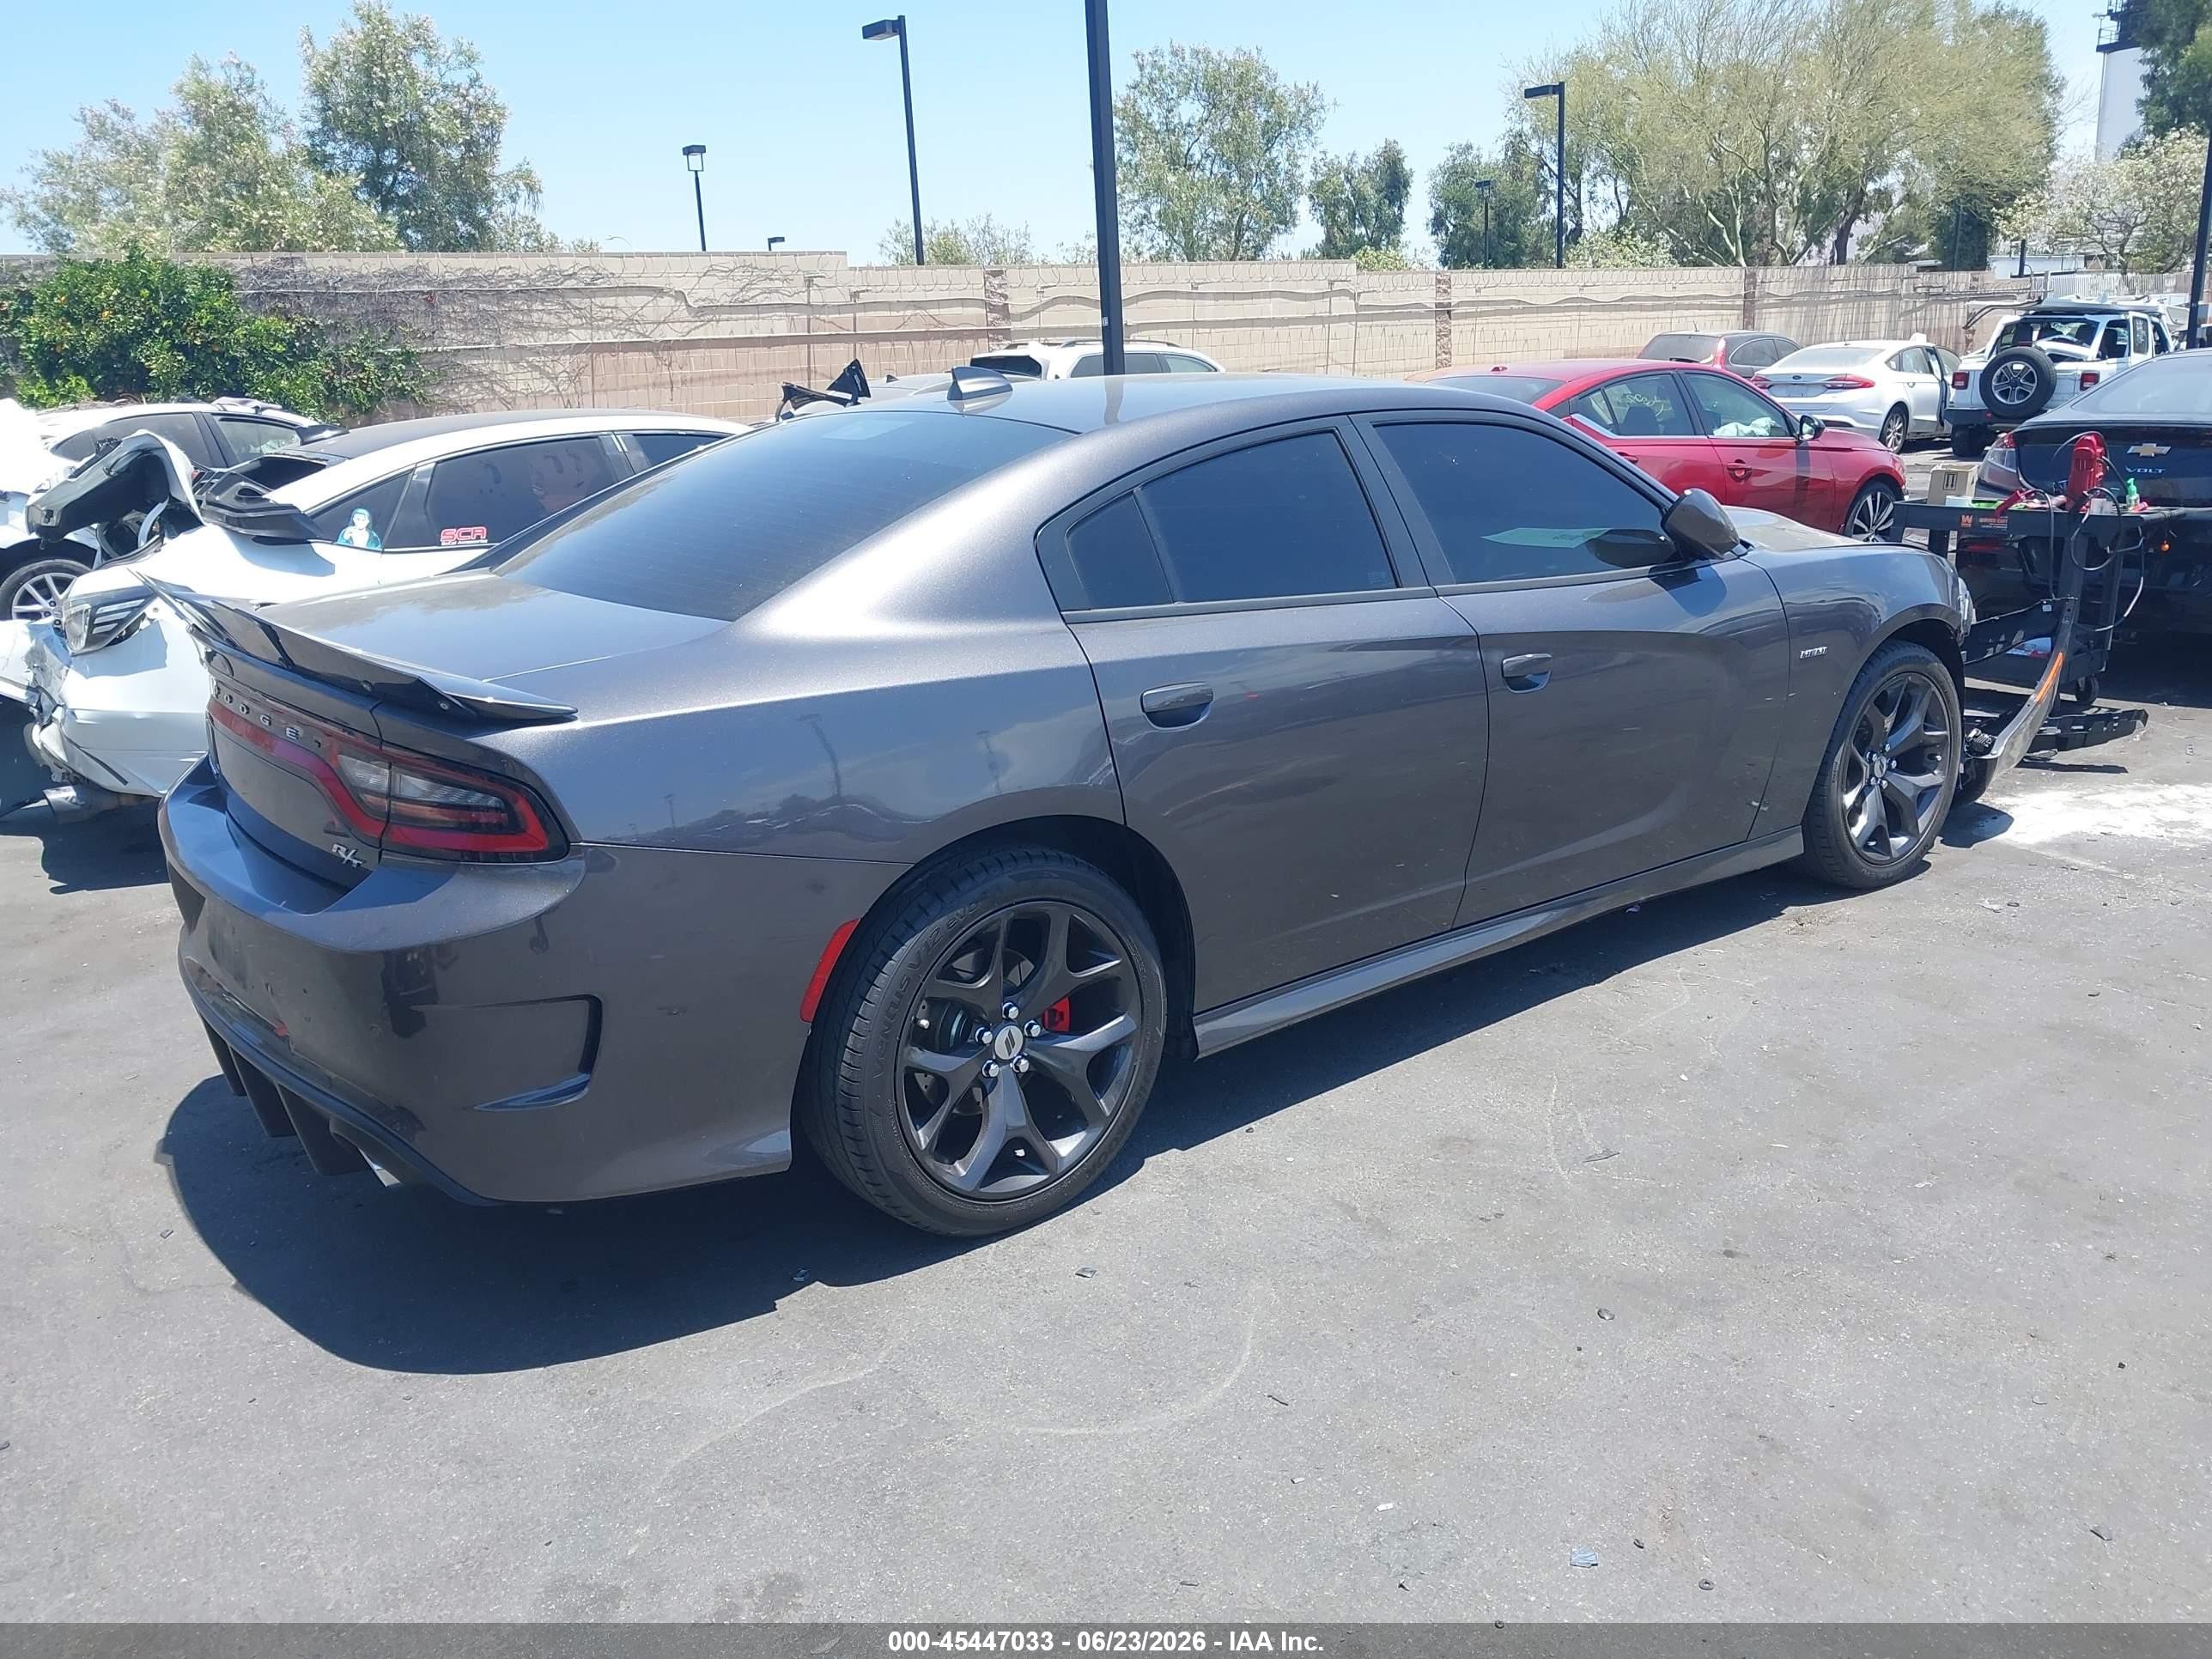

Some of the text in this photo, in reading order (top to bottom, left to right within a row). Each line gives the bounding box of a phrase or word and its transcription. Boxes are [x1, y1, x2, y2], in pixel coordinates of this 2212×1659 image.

[2125, 465, 2166, 474] VOLT
[441, 526, 487, 542] SCA
[331, 843, 363, 869] R/T
